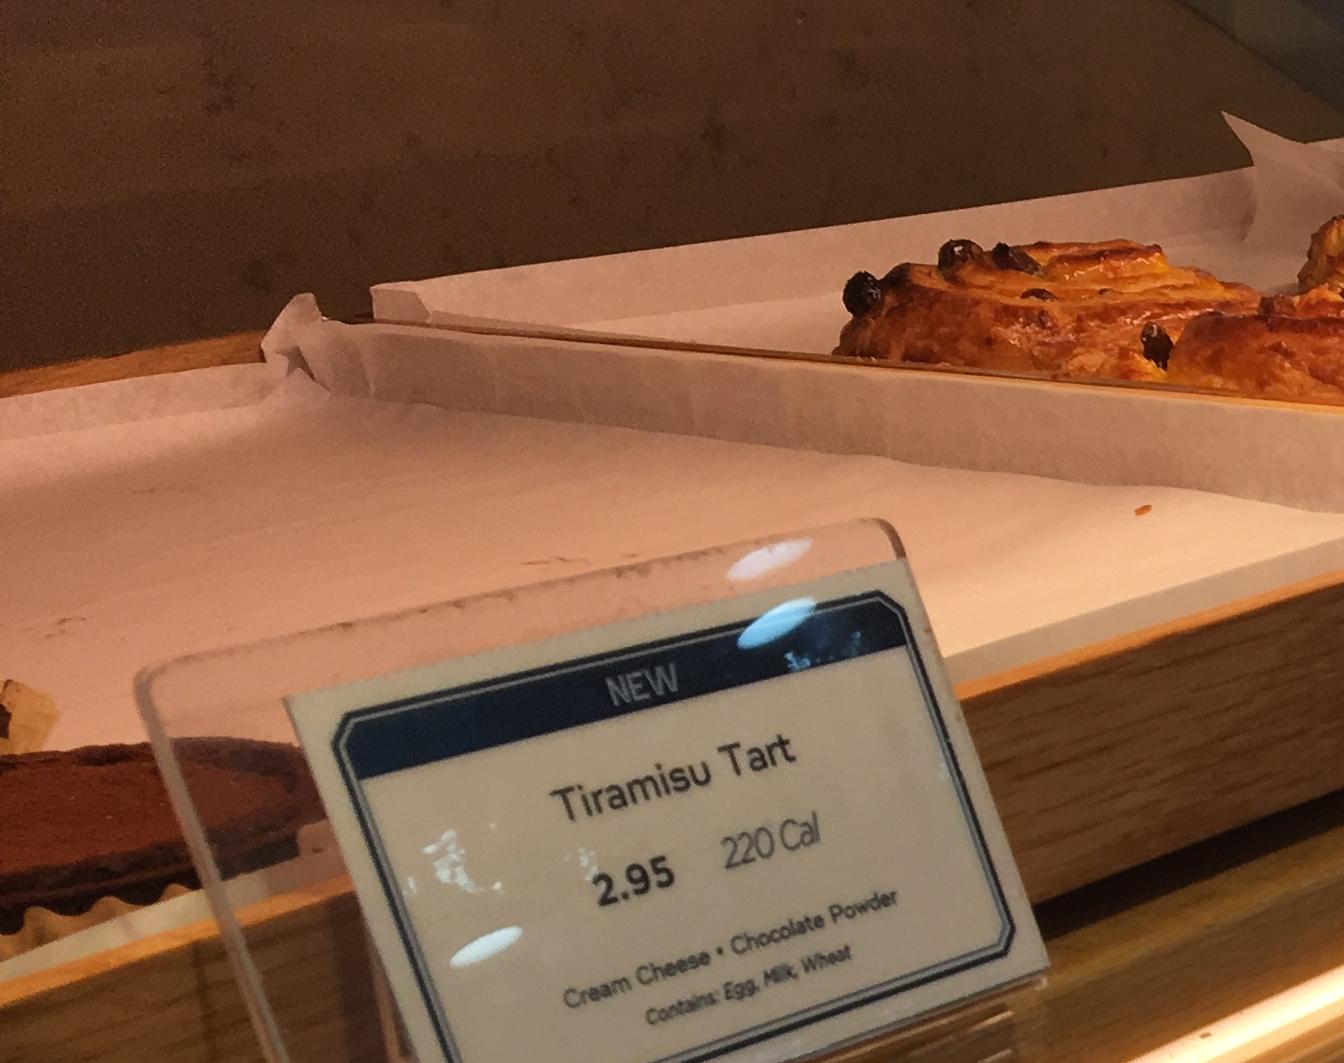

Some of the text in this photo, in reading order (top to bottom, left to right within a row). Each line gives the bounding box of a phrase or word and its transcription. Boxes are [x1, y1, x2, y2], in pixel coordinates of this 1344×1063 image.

[604, 663, 680, 706] NEW
[549, 734, 797, 822] Tiramisu Tart
[592, 811, 822, 907] 2.95 220 Cal
[562, 890, 898, 1009] Cream Cheese Chocolate Powder
[645, 990, 721, 1026] Contains:
[721, 979, 762, 1002] Egg,
[801, 945, 854, 974] Wheat
